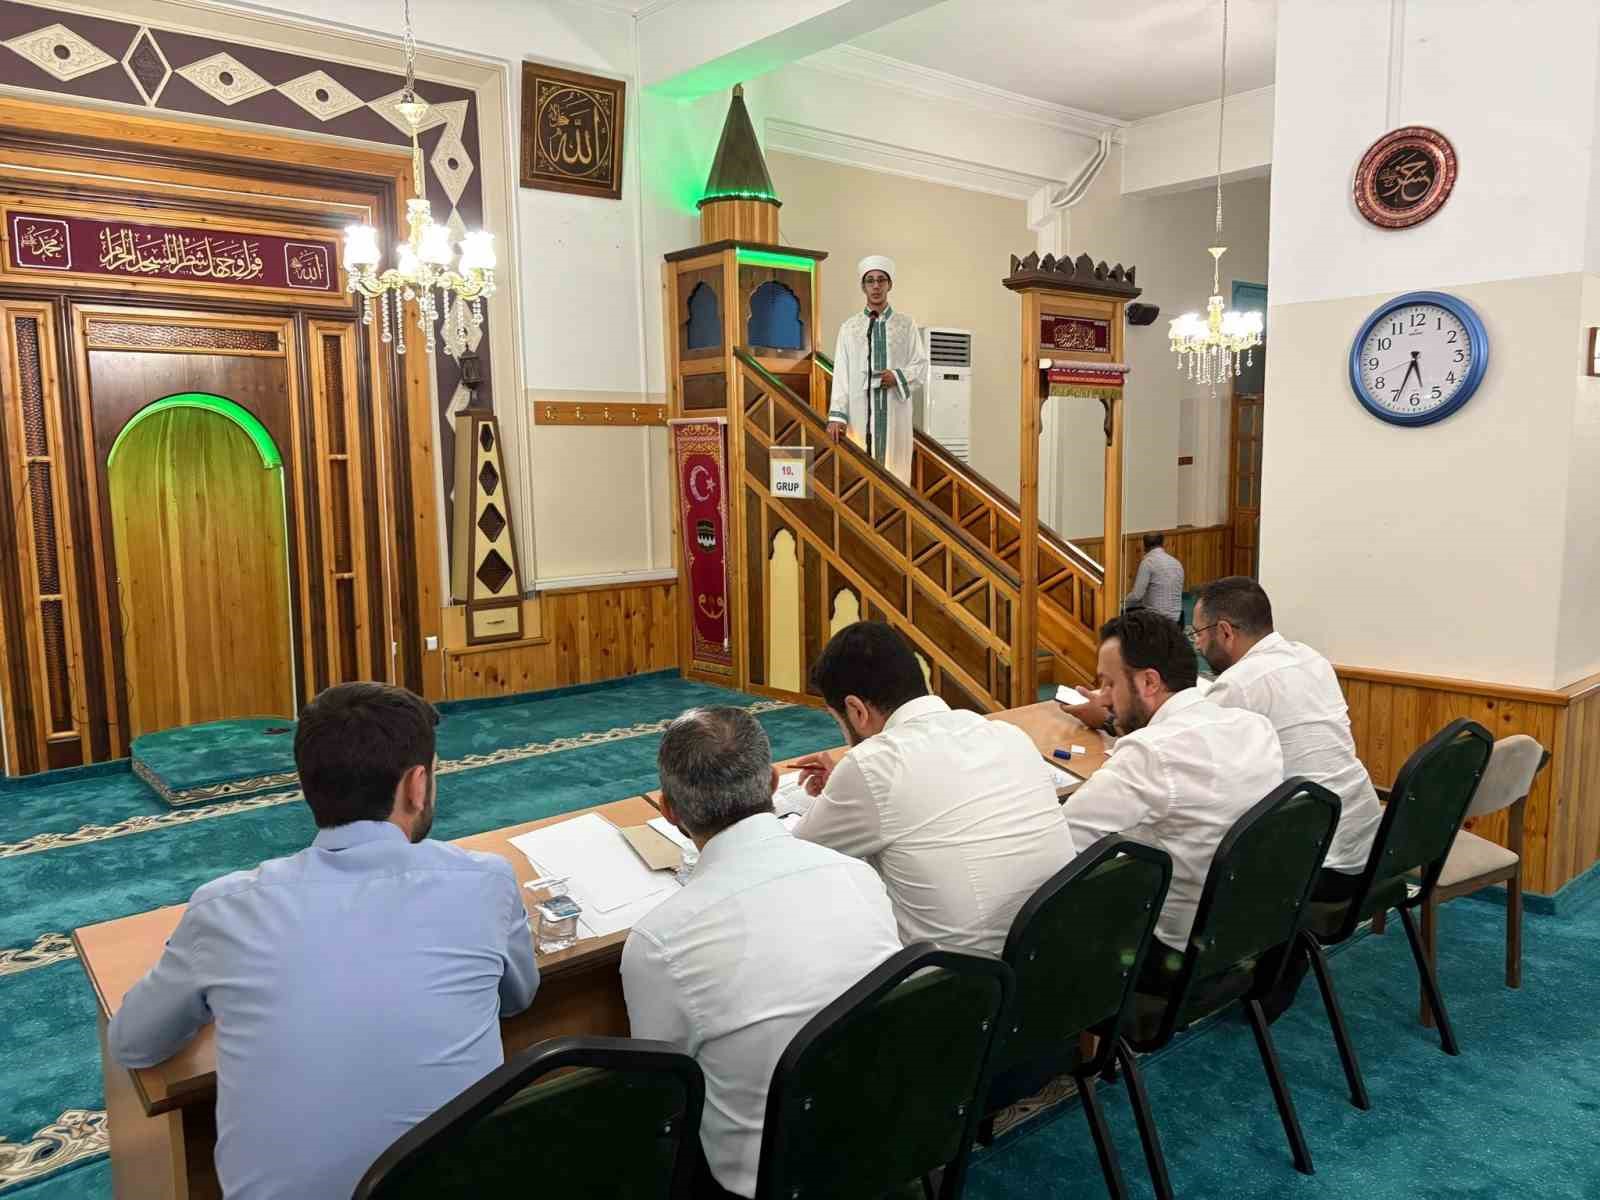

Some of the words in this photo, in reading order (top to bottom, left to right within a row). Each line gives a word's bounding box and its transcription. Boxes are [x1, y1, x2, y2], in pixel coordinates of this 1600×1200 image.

[1409, 313, 1426, 327] 12
[1436, 317, 1442, 331] 1
[1391, 322, 1404, 335] 11
[1377, 337, 1392, 351] 10
[1447, 330, 1457, 344] 2
[1453, 349, 1465, 363] 3
[1368, 357, 1379, 371] 9
[1375, 376, 1385, 389] 8
[1446, 370, 1456, 385] 4
[1391, 389, 1401, 402] 7
[1409, 393, 1420, 406] 6
[1431, 386, 1442, 399] 5
[776, 481, 800, 492] GRUP
